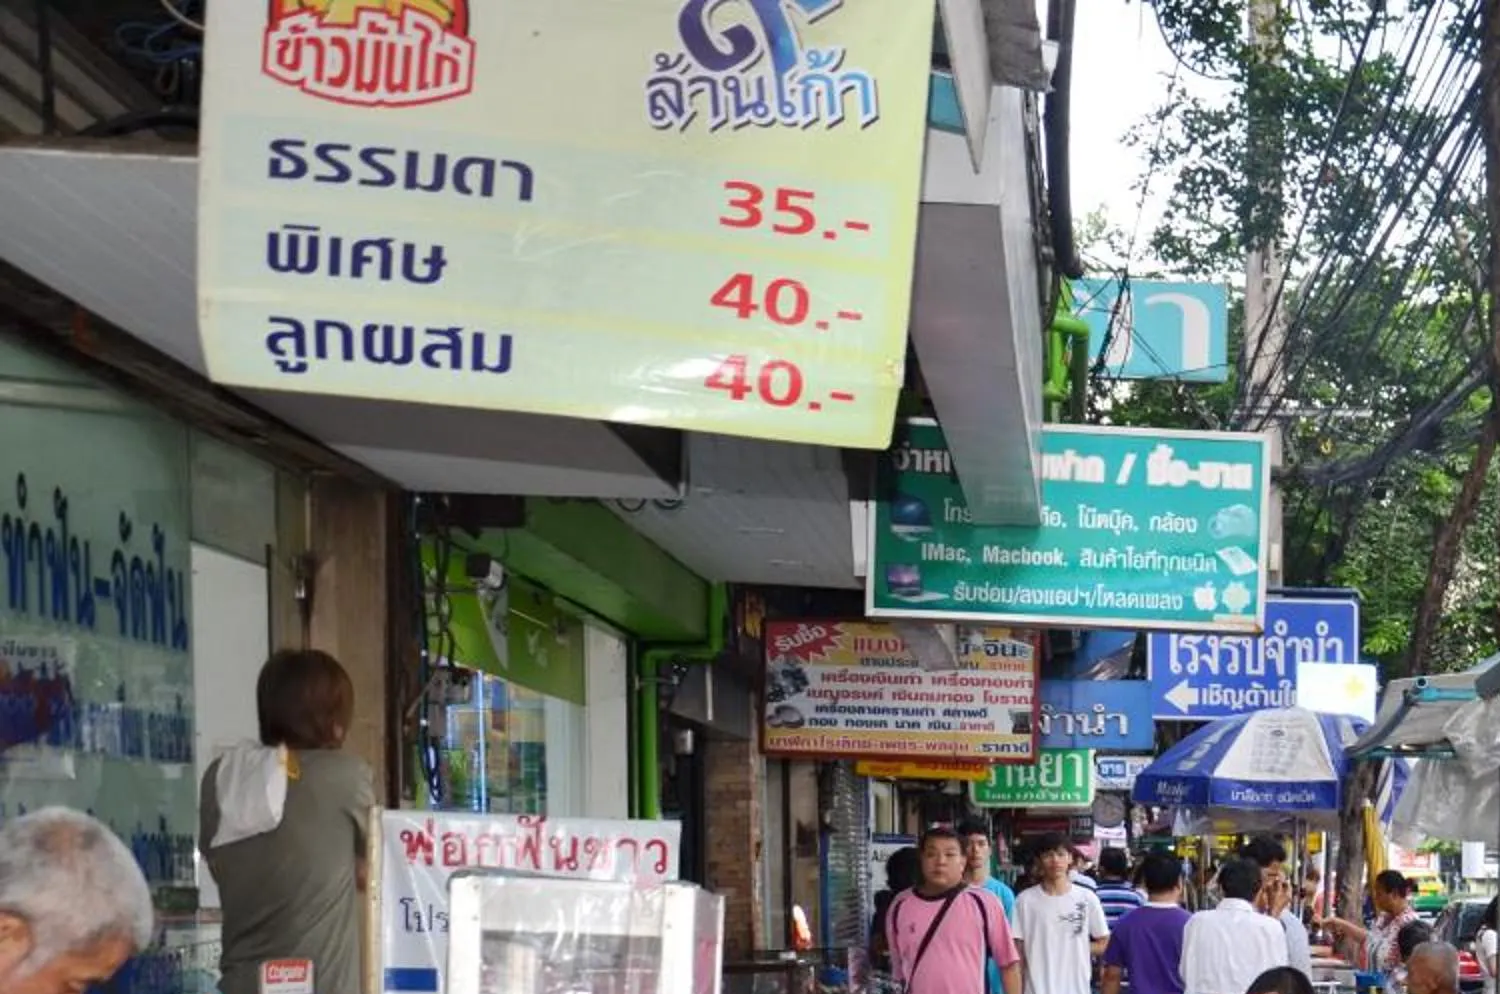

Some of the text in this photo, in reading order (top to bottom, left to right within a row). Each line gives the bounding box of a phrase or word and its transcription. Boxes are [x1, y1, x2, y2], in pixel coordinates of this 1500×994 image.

[277, 20, 462, 93] ข้าวมันไก่
[646, 49, 877, 128] ล้านเก้า
[267, 137, 871, 241] ธรรมดา 35.-
[266, 223, 864, 331] พิเศษ 40.-
[265, 314, 856, 412] ลูกผสม 40.-
[1168, 620, 1345, 677] โรงรบจำนำ
[1201, 679, 1298, 710] เชิญด้านใ
[987, 753, 1084, 788] รานยา
